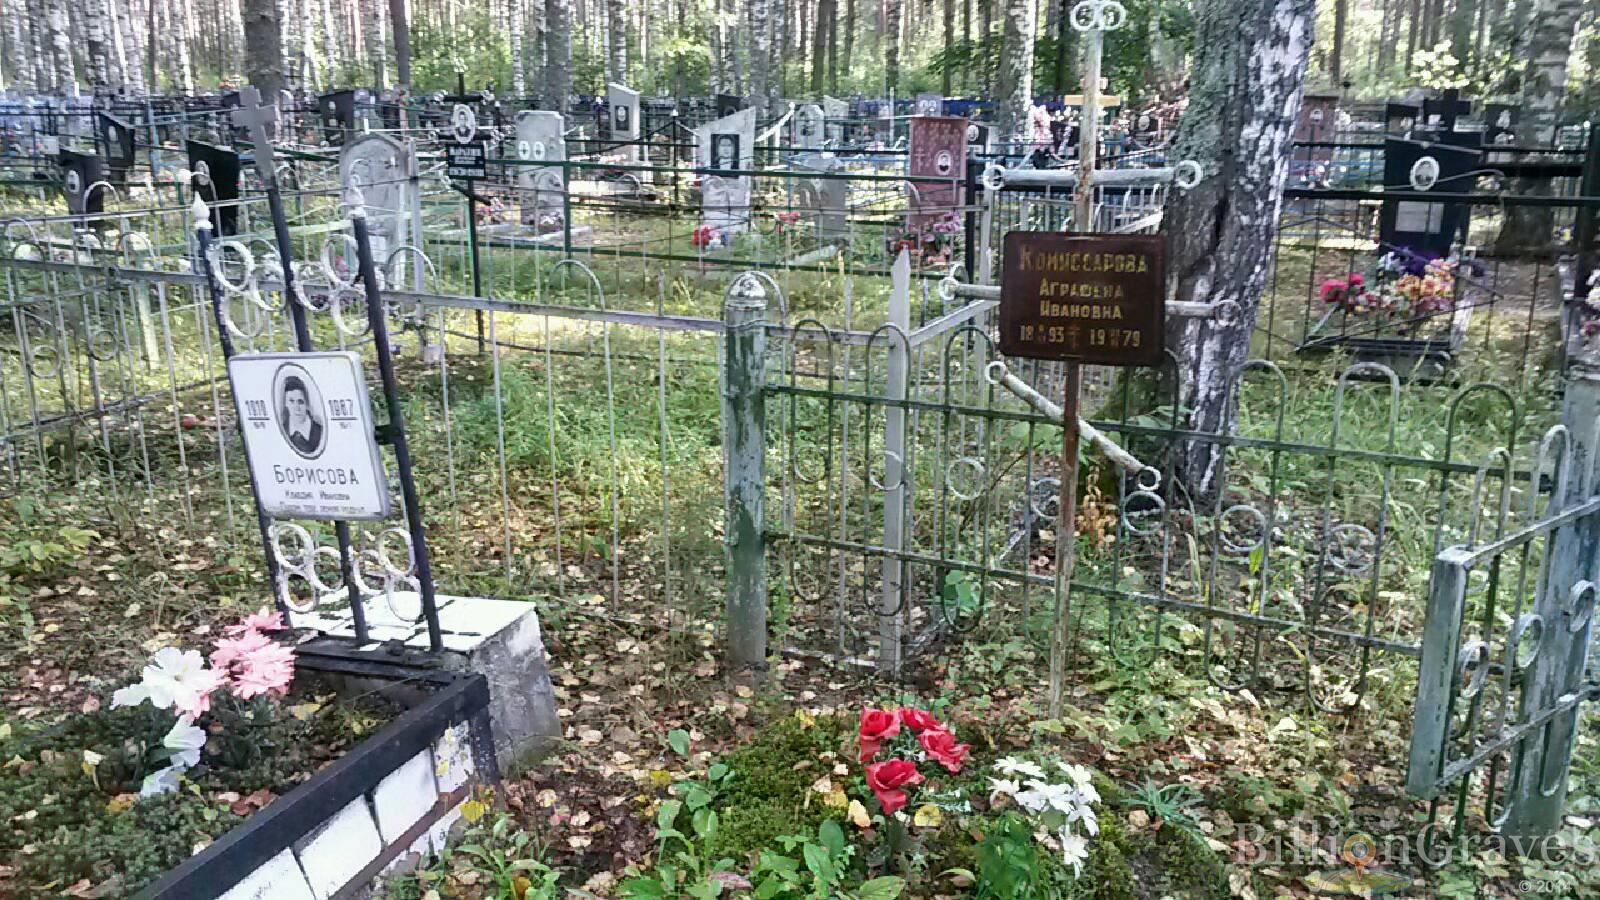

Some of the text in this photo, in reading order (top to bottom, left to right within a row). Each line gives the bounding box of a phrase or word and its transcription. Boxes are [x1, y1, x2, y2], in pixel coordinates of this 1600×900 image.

[1020, 244, 1148, 273] КОМИССАРОВА
[1040, 301, 1122, 320] ИВАНОВНА
[273, 464, 359, 485] БОРИСОВА
